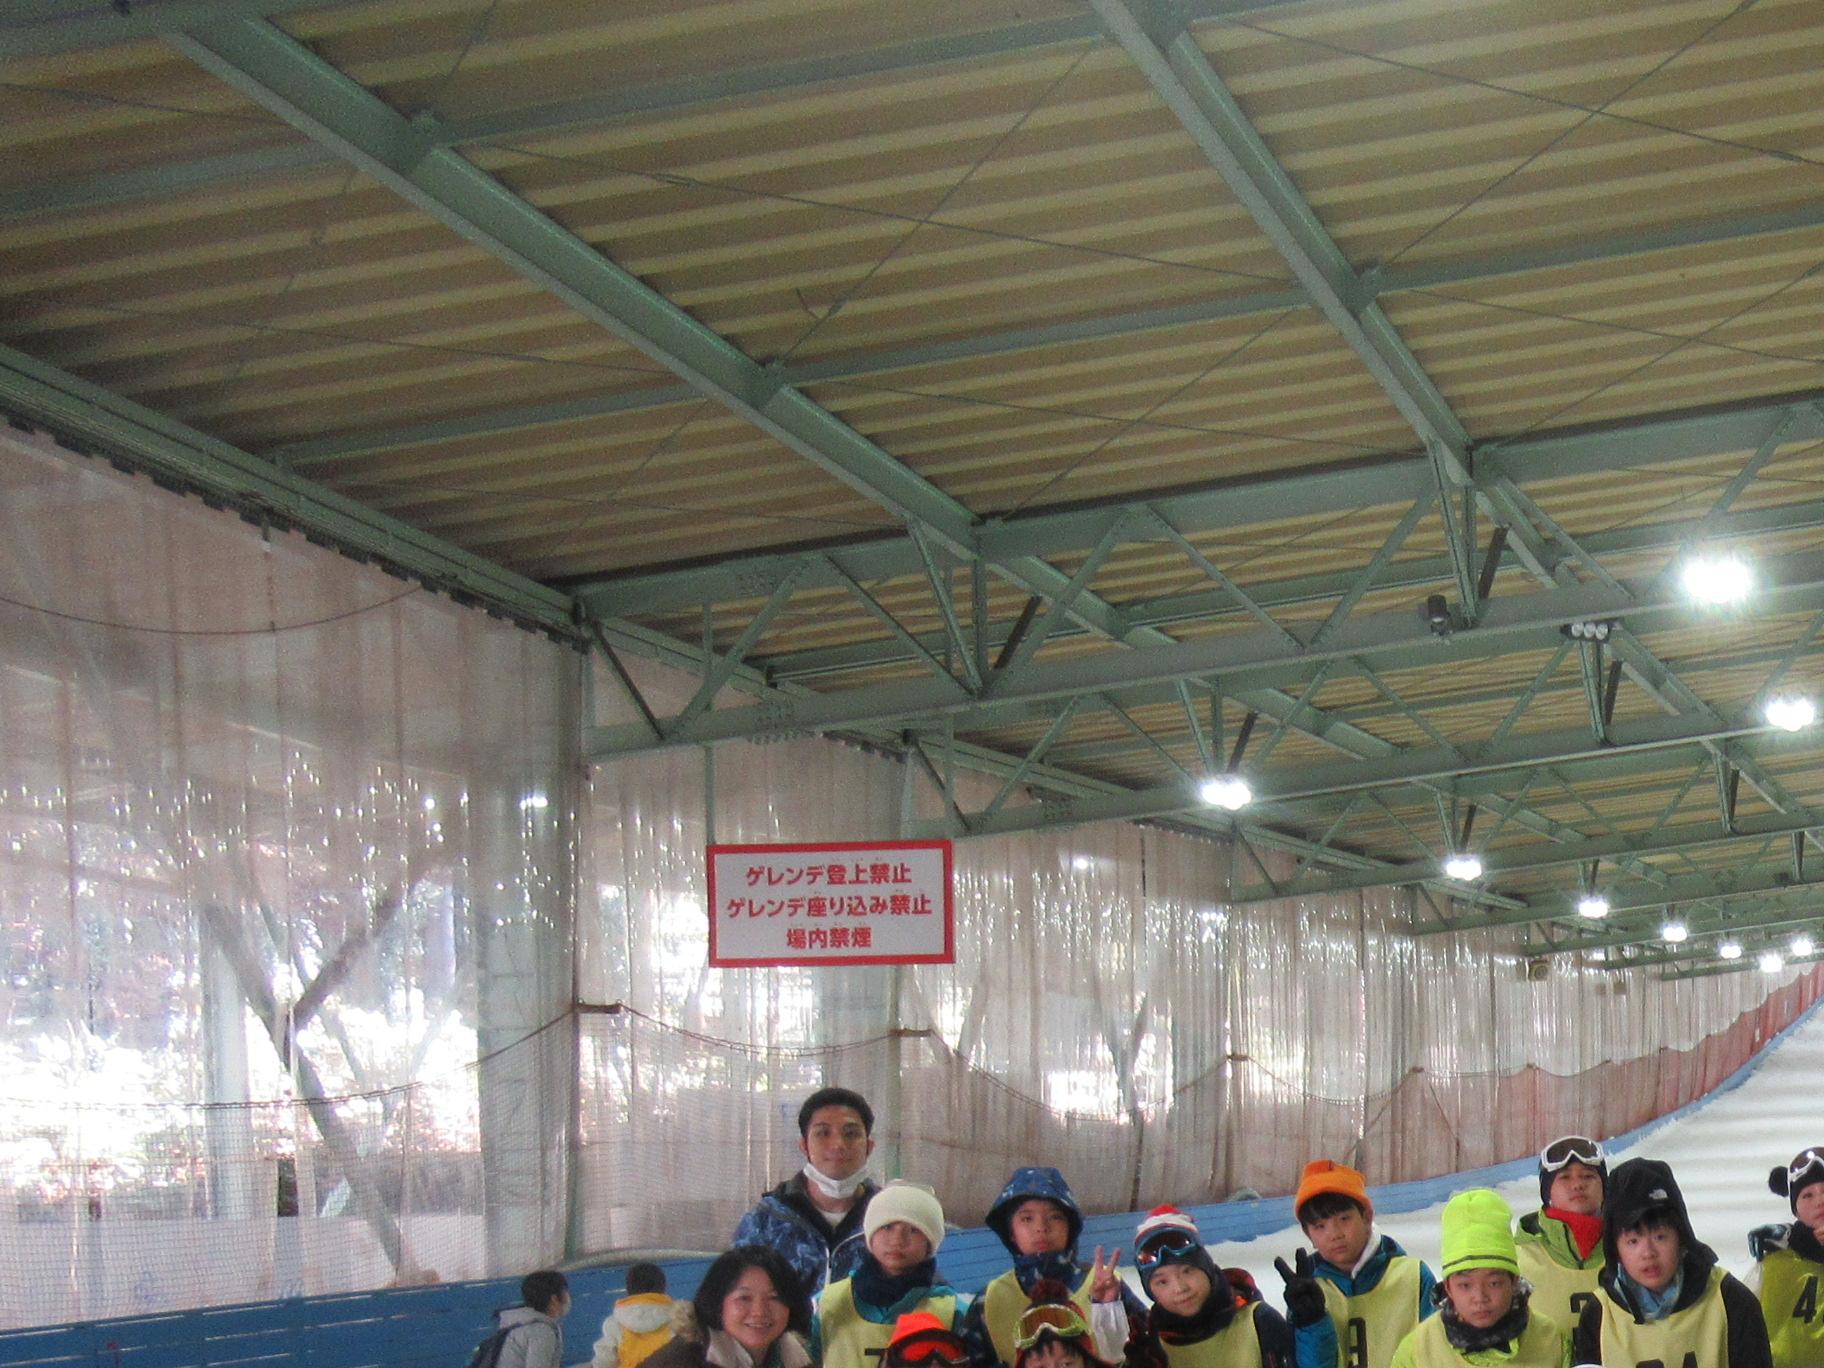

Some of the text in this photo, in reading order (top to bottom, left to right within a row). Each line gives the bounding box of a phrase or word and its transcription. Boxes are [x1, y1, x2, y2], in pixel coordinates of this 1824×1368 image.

[745, 863, 912, 886] ゲレンデ登上禁止
[727, 894, 932, 918] ゲレンデ座り込み禁止
[787, 927, 872, 949] 場内禁煙
